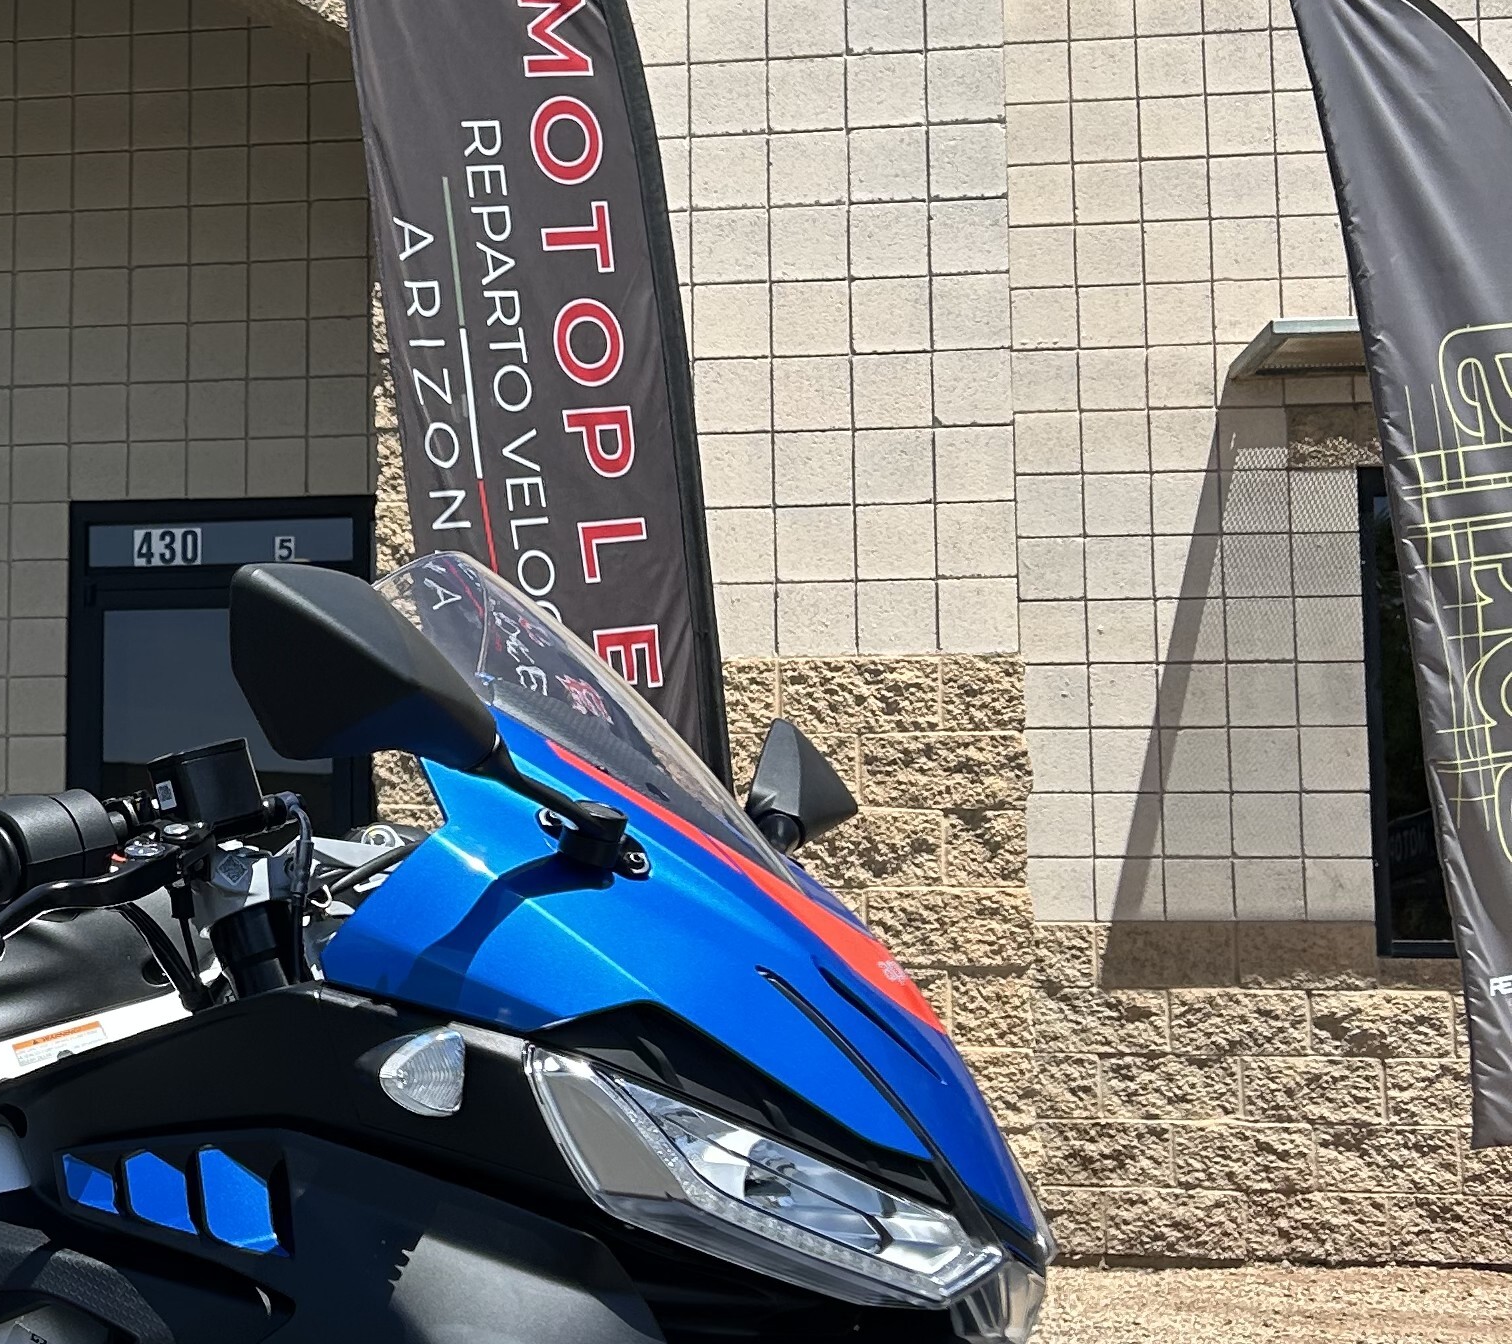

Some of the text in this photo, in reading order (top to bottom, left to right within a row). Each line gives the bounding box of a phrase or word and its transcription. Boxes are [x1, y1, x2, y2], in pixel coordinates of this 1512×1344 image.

[460, 119, 534, 414] REPARTO
[137, 530, 199, 564] 430
[279, 538, 293, 561] 5
